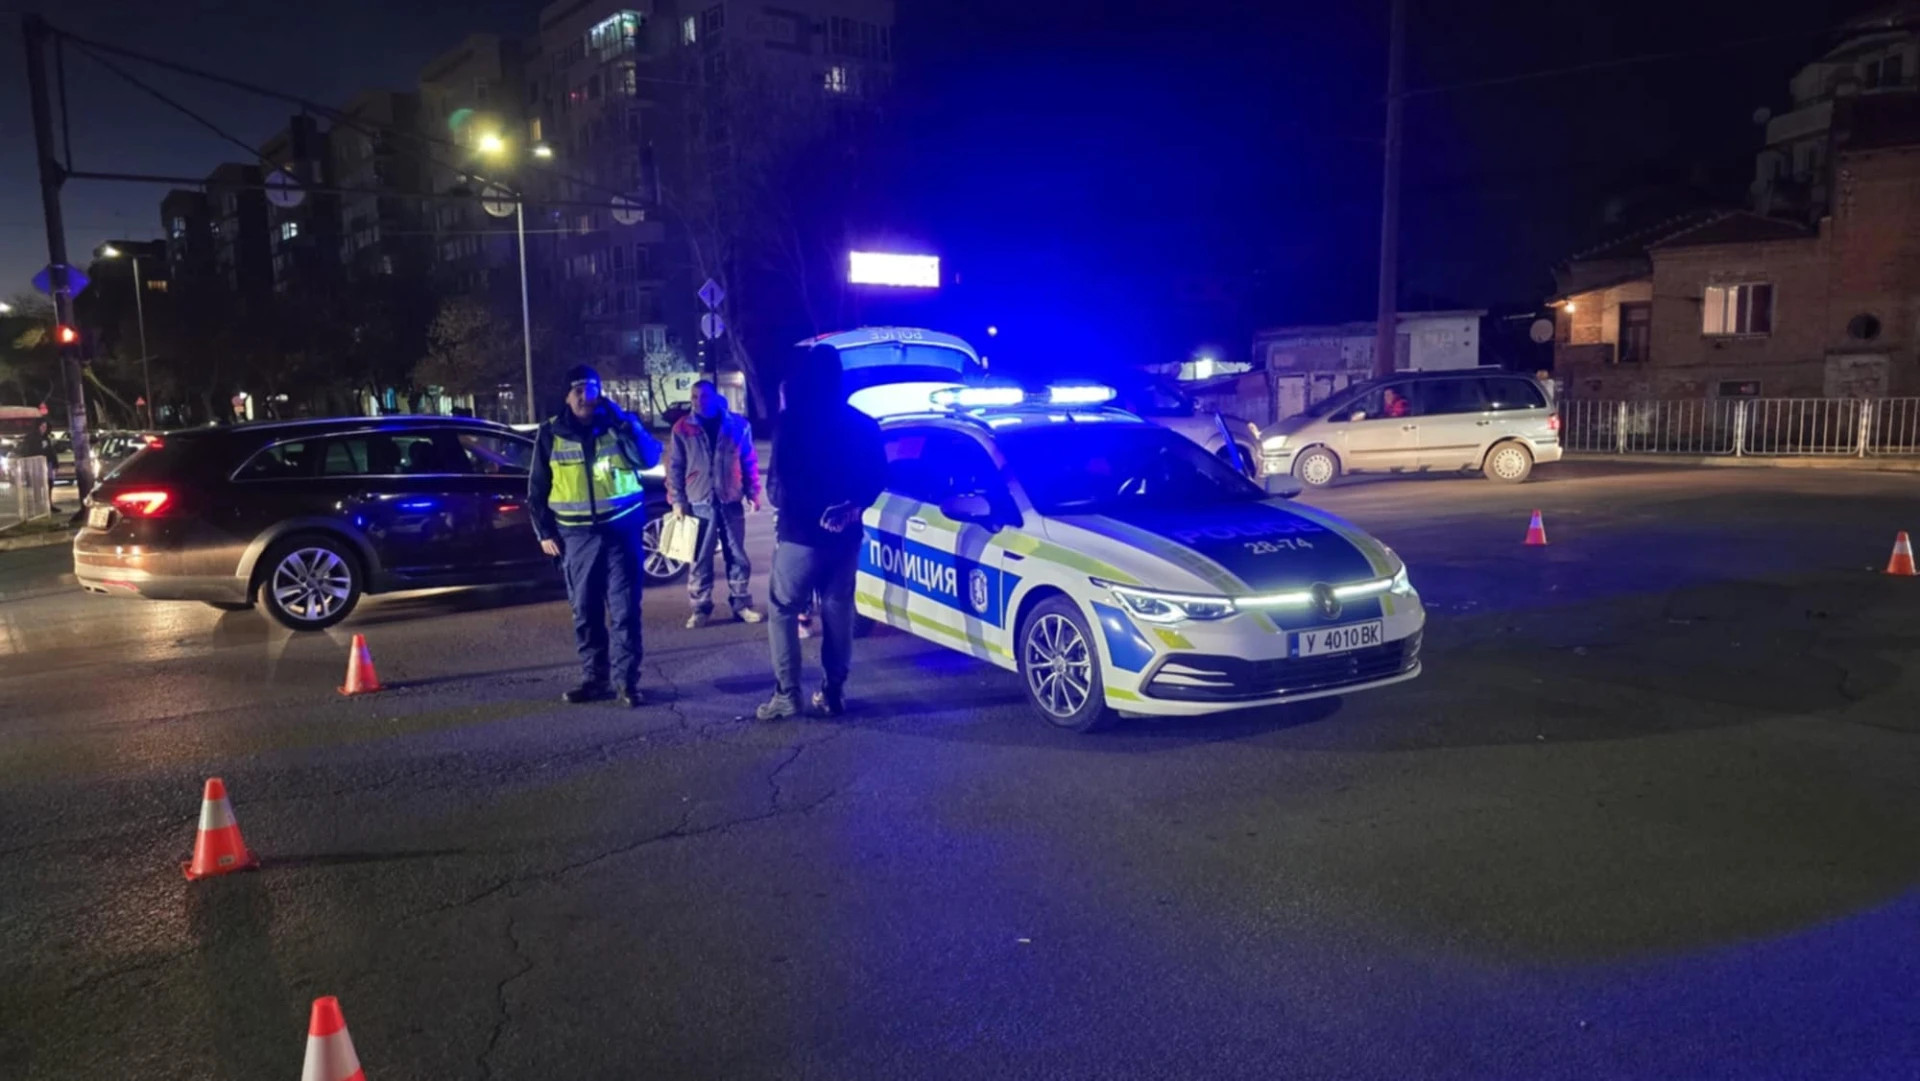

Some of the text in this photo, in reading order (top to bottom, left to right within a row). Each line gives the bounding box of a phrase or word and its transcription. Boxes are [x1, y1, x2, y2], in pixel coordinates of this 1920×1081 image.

[871, 330, 922, 340] POLICE
[1174, 520, 1323, 544] POLICE
[1244, 537, 1313, 554] 28-74
[869, 539, 958, 598] ПОЛИЦИЯ
